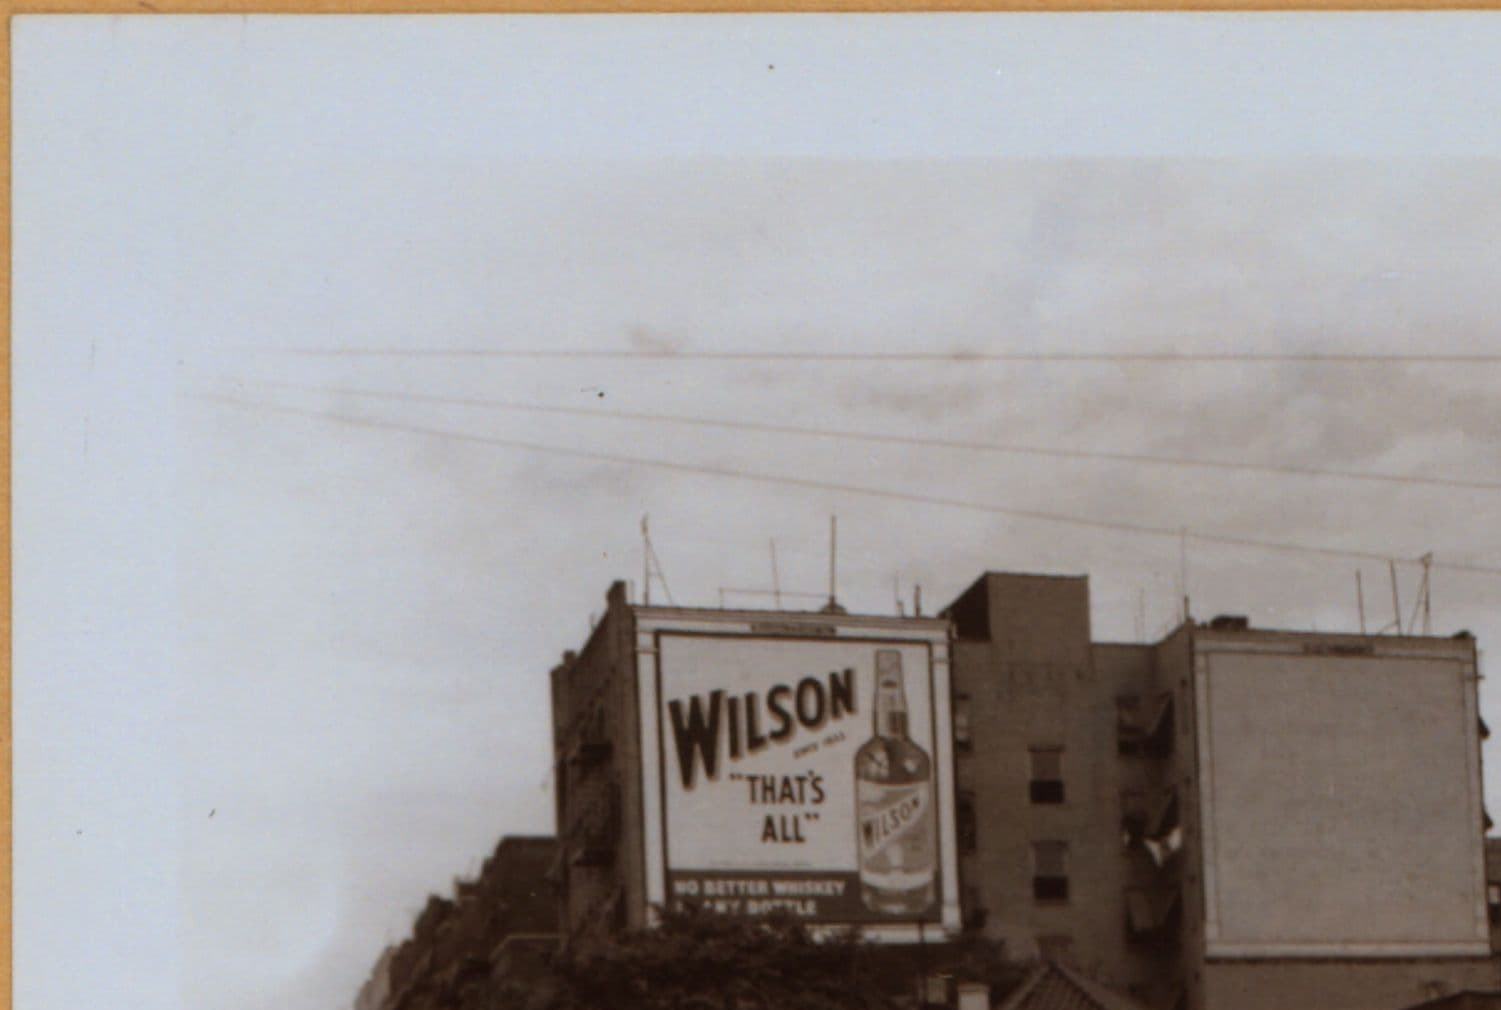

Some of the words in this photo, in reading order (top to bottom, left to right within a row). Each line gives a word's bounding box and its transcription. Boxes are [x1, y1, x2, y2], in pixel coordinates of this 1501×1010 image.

[668, 667, 857, 791] WILSON
[704, 880, 768, 896] BETTER
[773, 880, 845, 896] WHISKEY
